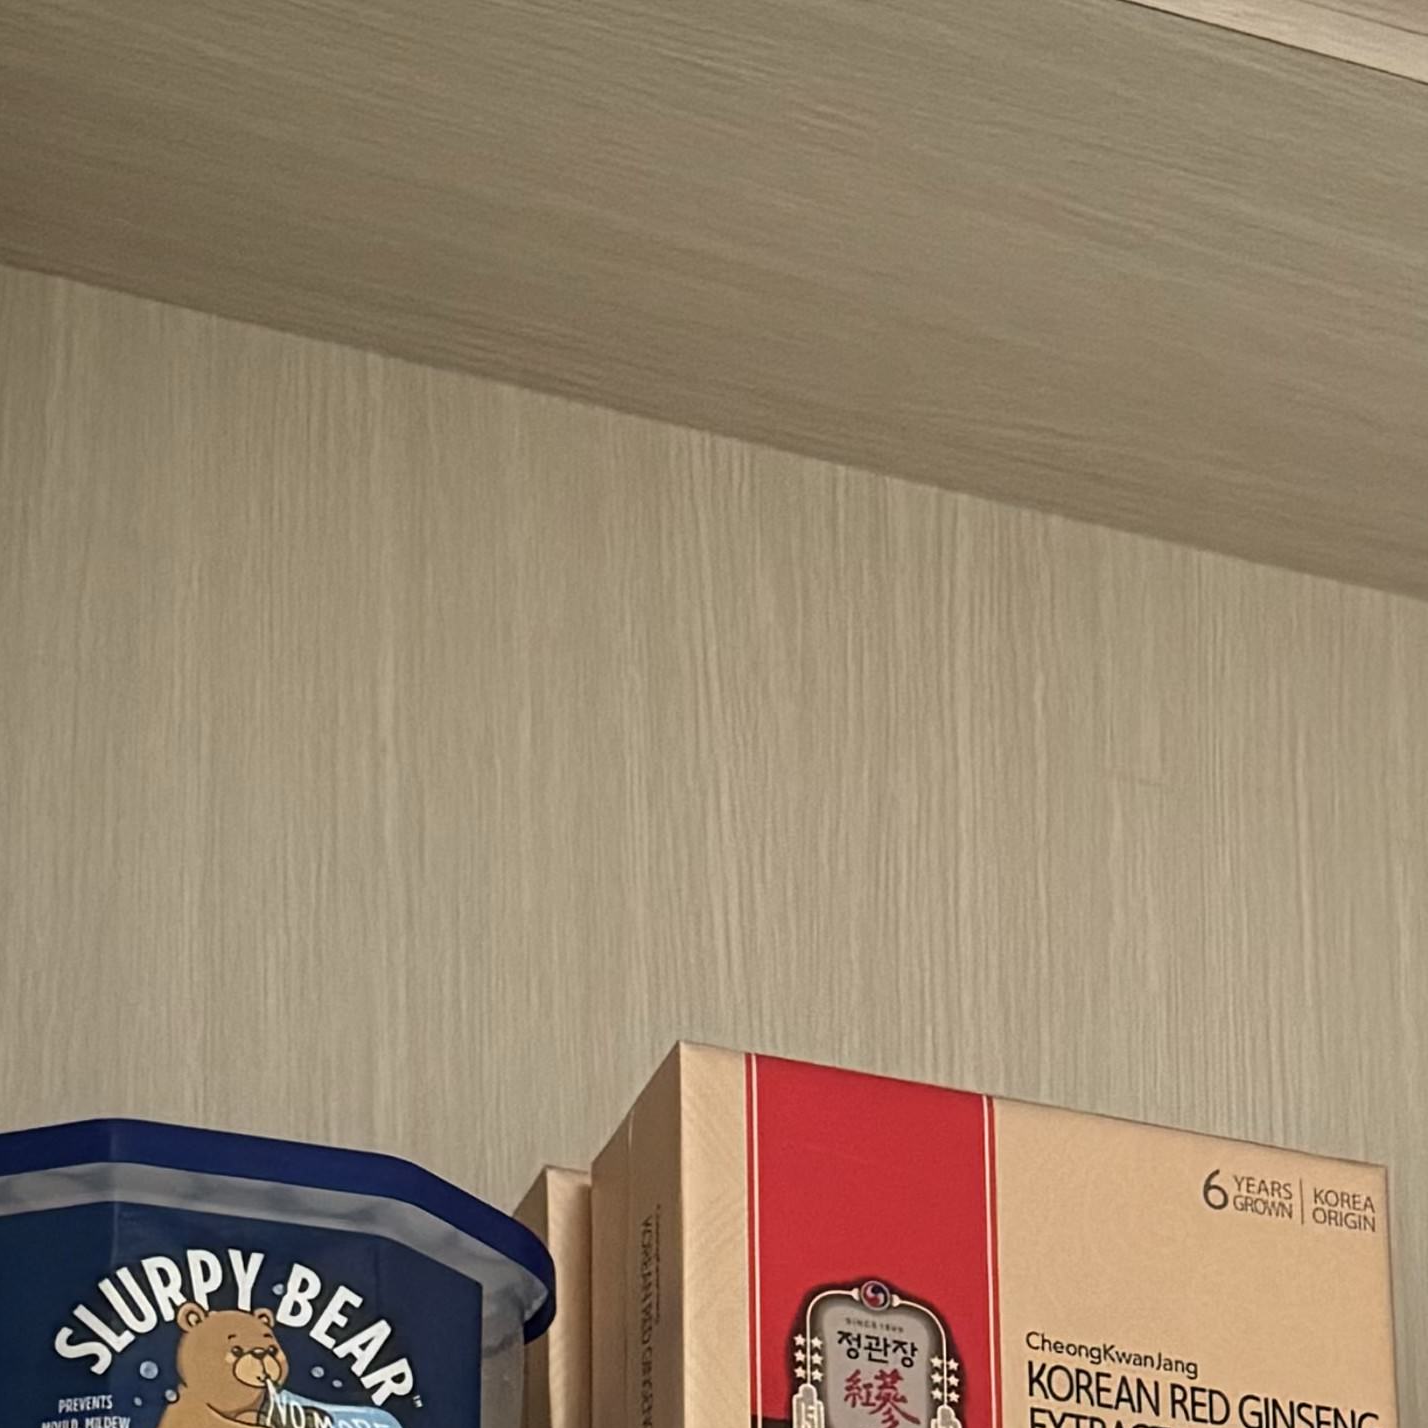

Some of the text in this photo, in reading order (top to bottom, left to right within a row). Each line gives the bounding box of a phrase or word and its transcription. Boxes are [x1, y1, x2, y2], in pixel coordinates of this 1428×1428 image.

[1203, 1169, 1375, 1213] 6 YEARS KOREA
[1233, 1195, 1376, 1233] GROWN ORIGIN
[54, 1249, 414, 1406] SLURPY BEAR
[837, 1330, 918, 1369] 정관장
[1026, 1331, 1199, 1379] CheongKwanJang
[58, 1395, 113, 1413] PREVENTS
[1028, 1360, 1160, 1417] KOREAN
[1171, 1383, 1230, 1425] RED
